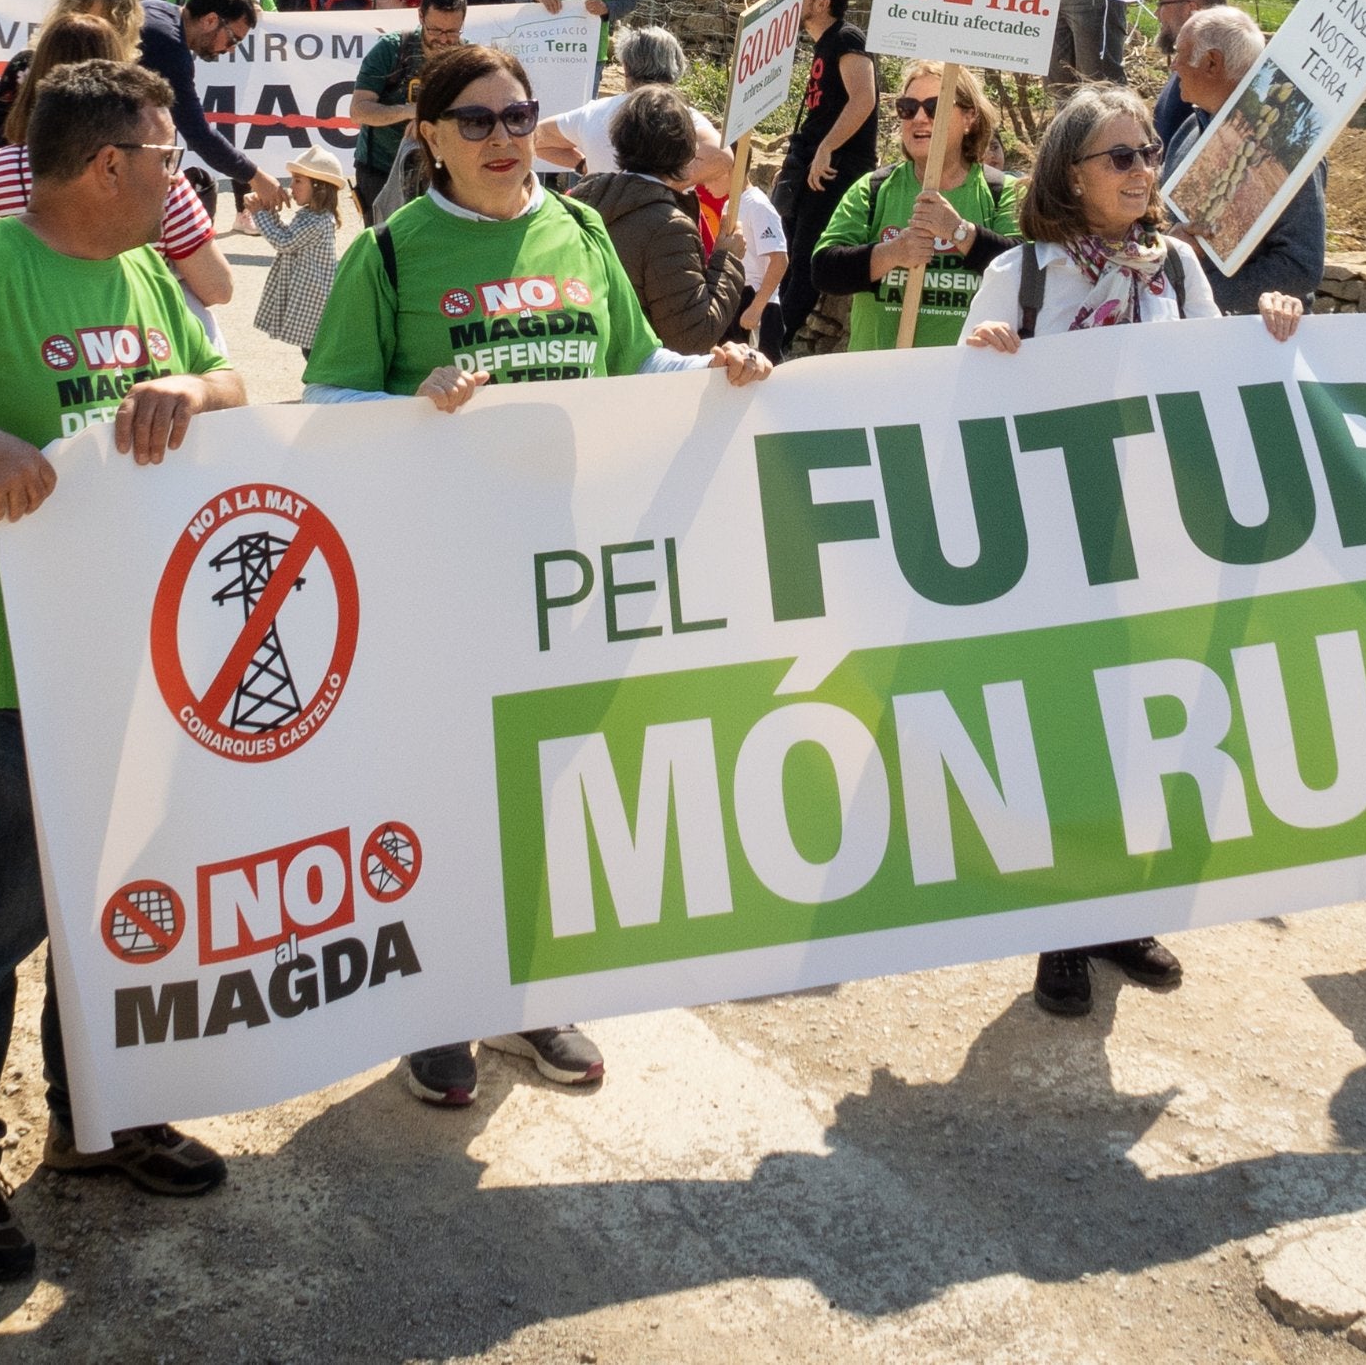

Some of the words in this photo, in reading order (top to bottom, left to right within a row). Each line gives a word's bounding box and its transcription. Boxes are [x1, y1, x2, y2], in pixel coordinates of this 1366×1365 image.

[518, 26, 588, 39] ASSOCIACIÓ
[887, 4, 907, 19] de
[911, 9, 959, 26] cultiu
[963, 15, 1041, 38] afectades
[545, 39, 588, 53] Terra
[738, 2, 800, 84] 60.000
[950, 46, 1030, 65] www.nostraterra.org
[1310, 12, 1365, 78] NOSTRA
[1301, 47, 1347, 103] TERRA
[482, 279, 556, 312] NO
[881, 269, 981, 291] EFNSEM
[81, 330, 141, 366] NO
[449, 311, 598, 350] MAGDA
[454, 339, 598, 375] DEFENSEM
[56, 368, 173, 408] MAG
[187, 508, 215, 542] NO
[219, 498, 233, 519] A
[235, 490, 262, 511] LA
[265, 490, 308, 519] MAT
[533, 536, 729, 652] PEL
[179, 705, 276, 756] COMARQUES
[538, 658, 1054, 939] MÓN
[209, 844, 347, 951] NO
[275, 932, 299, 966] al
[115, 920, 422, 1048] MAGDA
